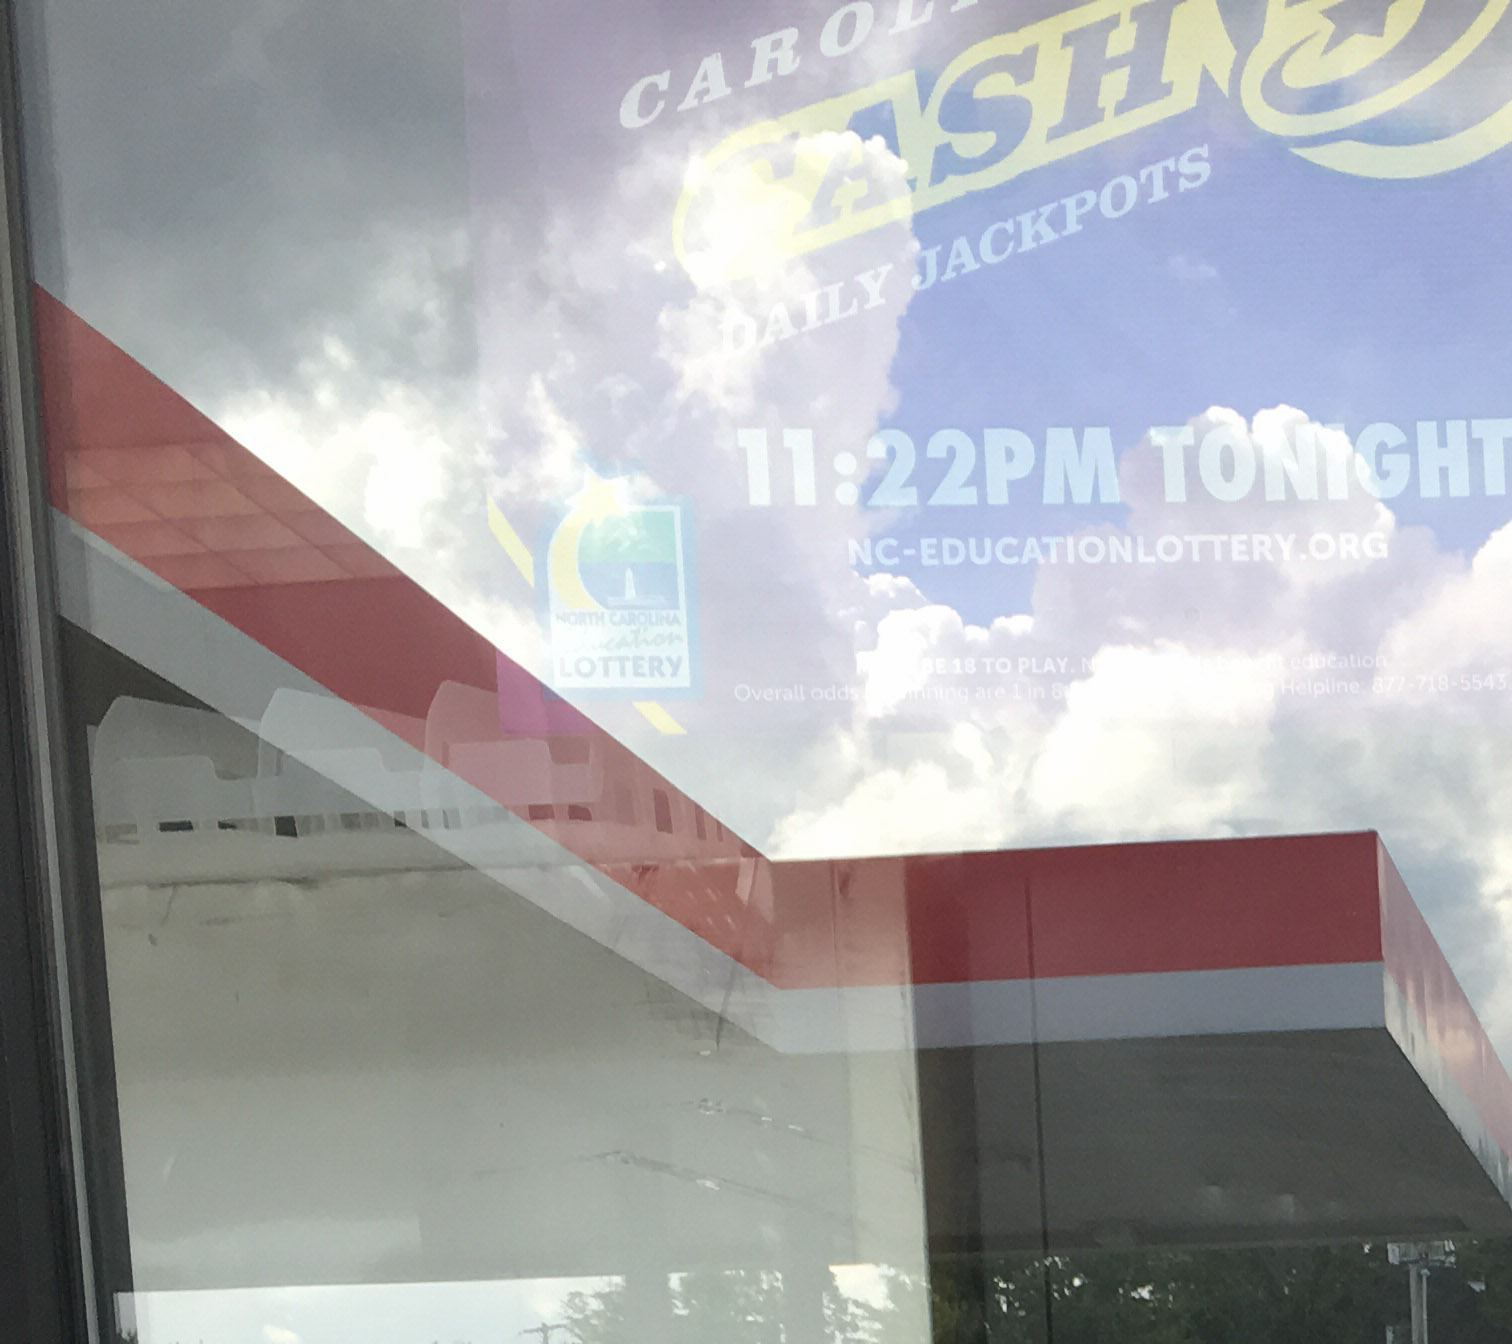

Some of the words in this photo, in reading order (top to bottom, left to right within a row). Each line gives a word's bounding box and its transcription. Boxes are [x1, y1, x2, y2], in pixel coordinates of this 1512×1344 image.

[618, 0, 979, 129] CAROL
[718, 263, 894, 354] DAILY
[910, 142, 1212, 291] JACKPOTS
[737, 426, 1121, 506] 11:22PM
[847, 531, 1389, 567] NC-EDUCATIONLOTTERY.ORG
[609, 610, 682, 627] CAROLINA
[559, 654, 683, 679] LOTTERY
[951, 656, 977, 675] 18
[981, 656, 1012, 675] TO
[1018, 655, 1076, 675] PLAY.
[733, 682, 805, 702] Overall
[810, 683, 860, 701] odds
